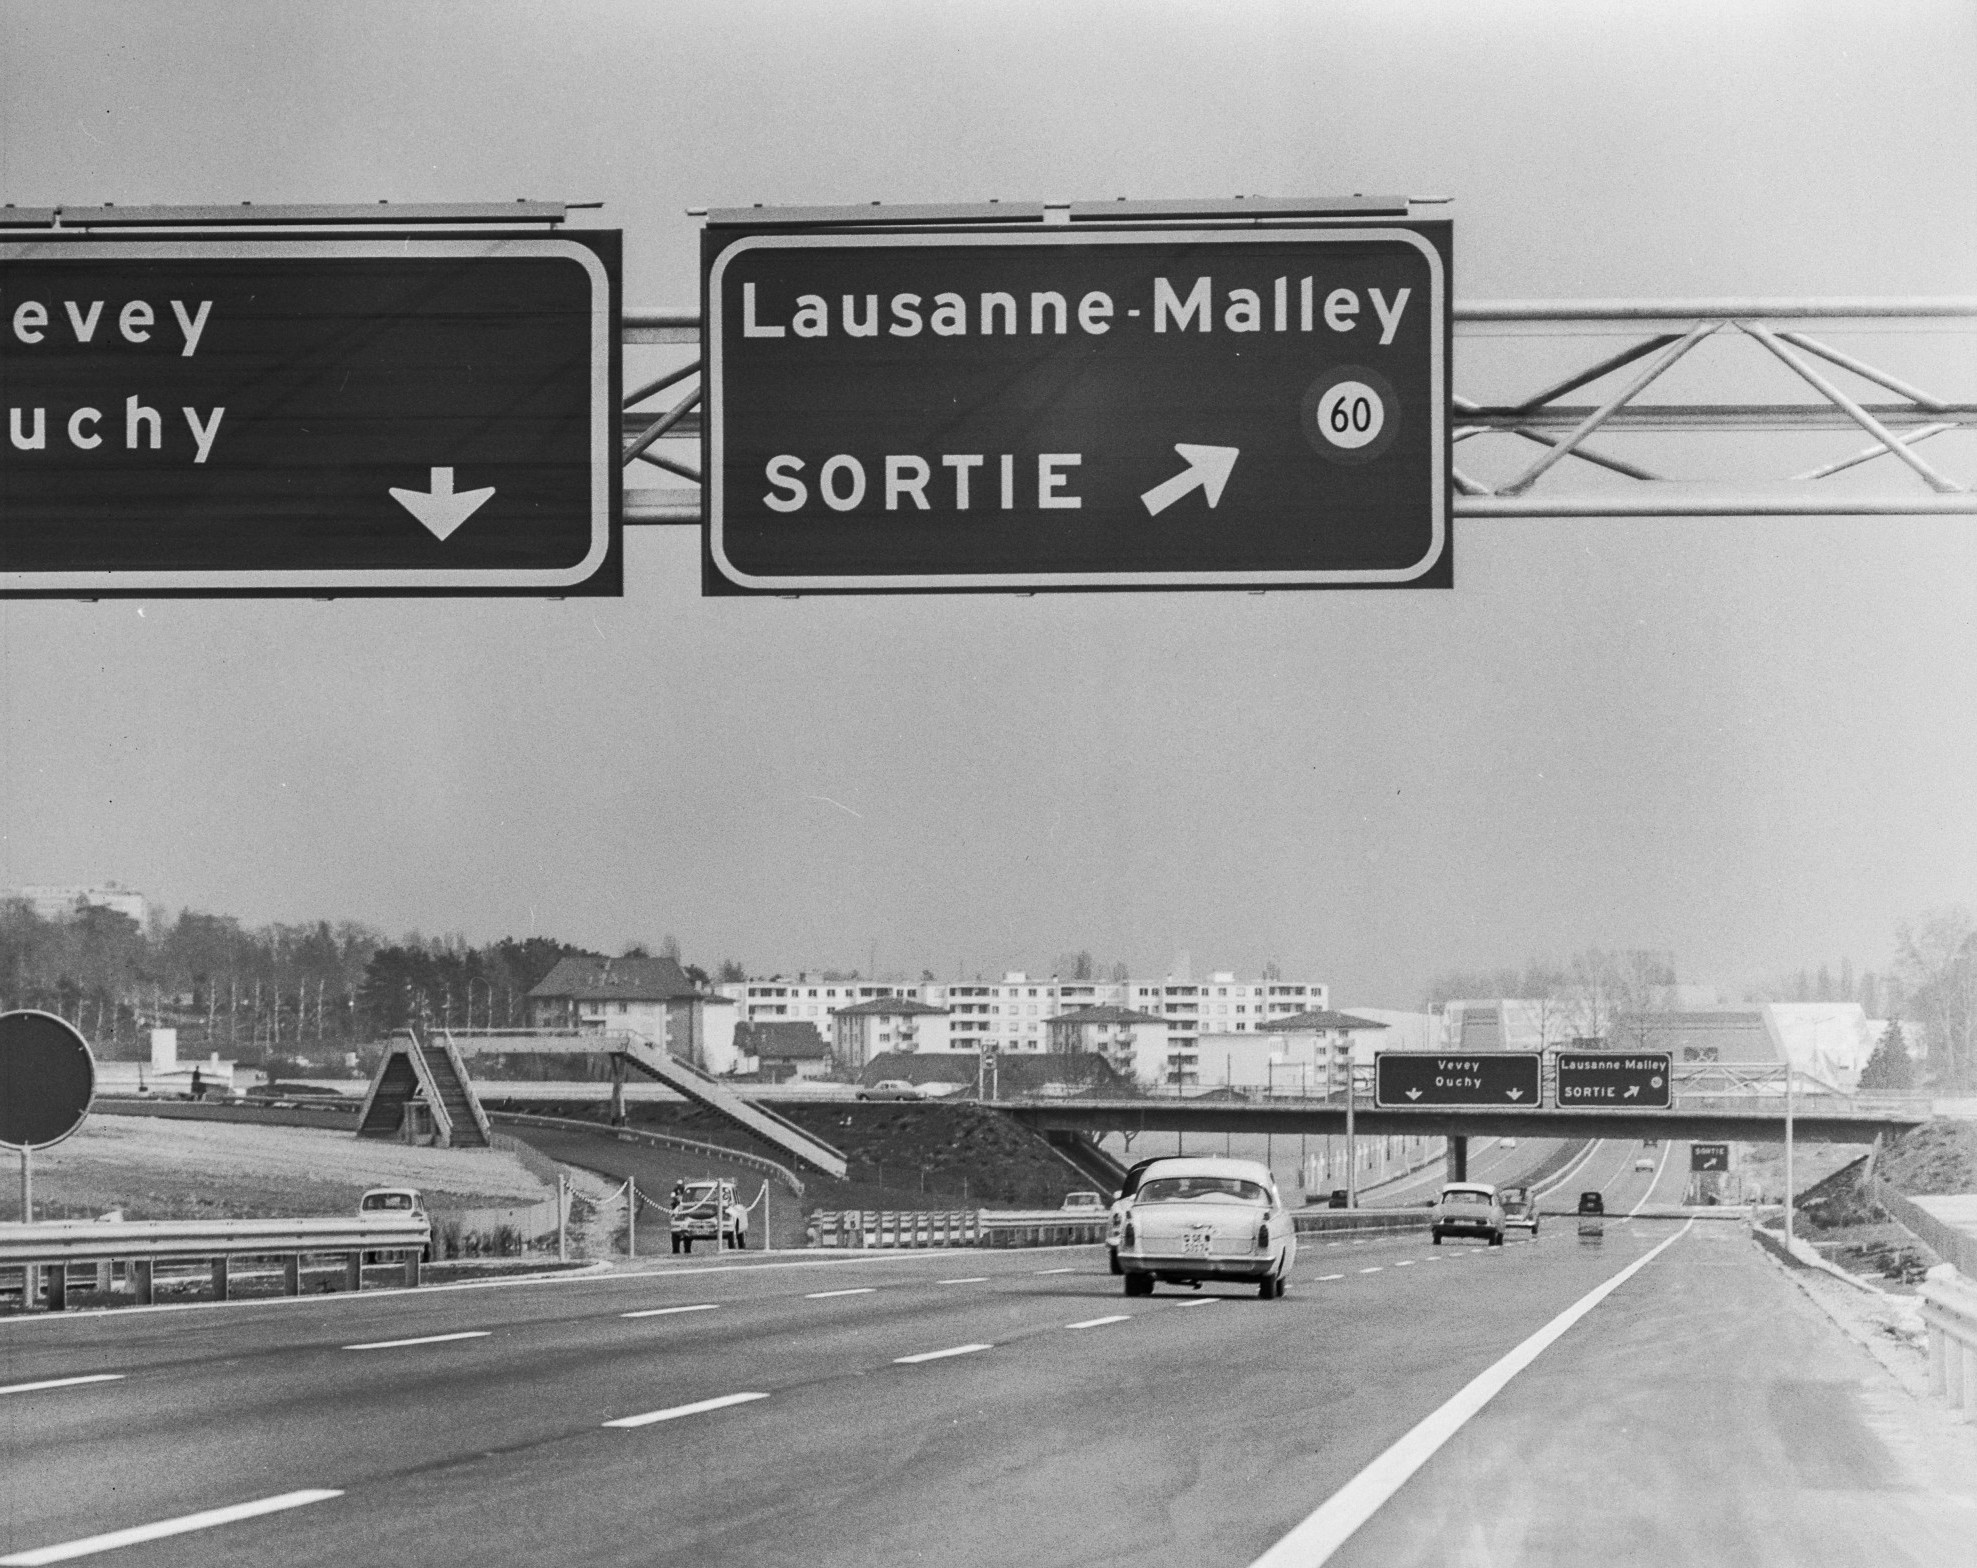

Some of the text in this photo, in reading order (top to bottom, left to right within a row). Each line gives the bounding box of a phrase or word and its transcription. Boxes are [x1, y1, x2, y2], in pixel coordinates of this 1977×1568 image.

[743, 275, 1412, 346] Lausanne-Malley
[1330, 395, 1372, 433] 60
[762, 452, 1083, 513] SORTIE
[1437, 1060, 1481, 1073] Vevey
[1435, 1077, 1482, 1089] Ouchy
[1564, 1086, 1616, 1098] SORTIE
